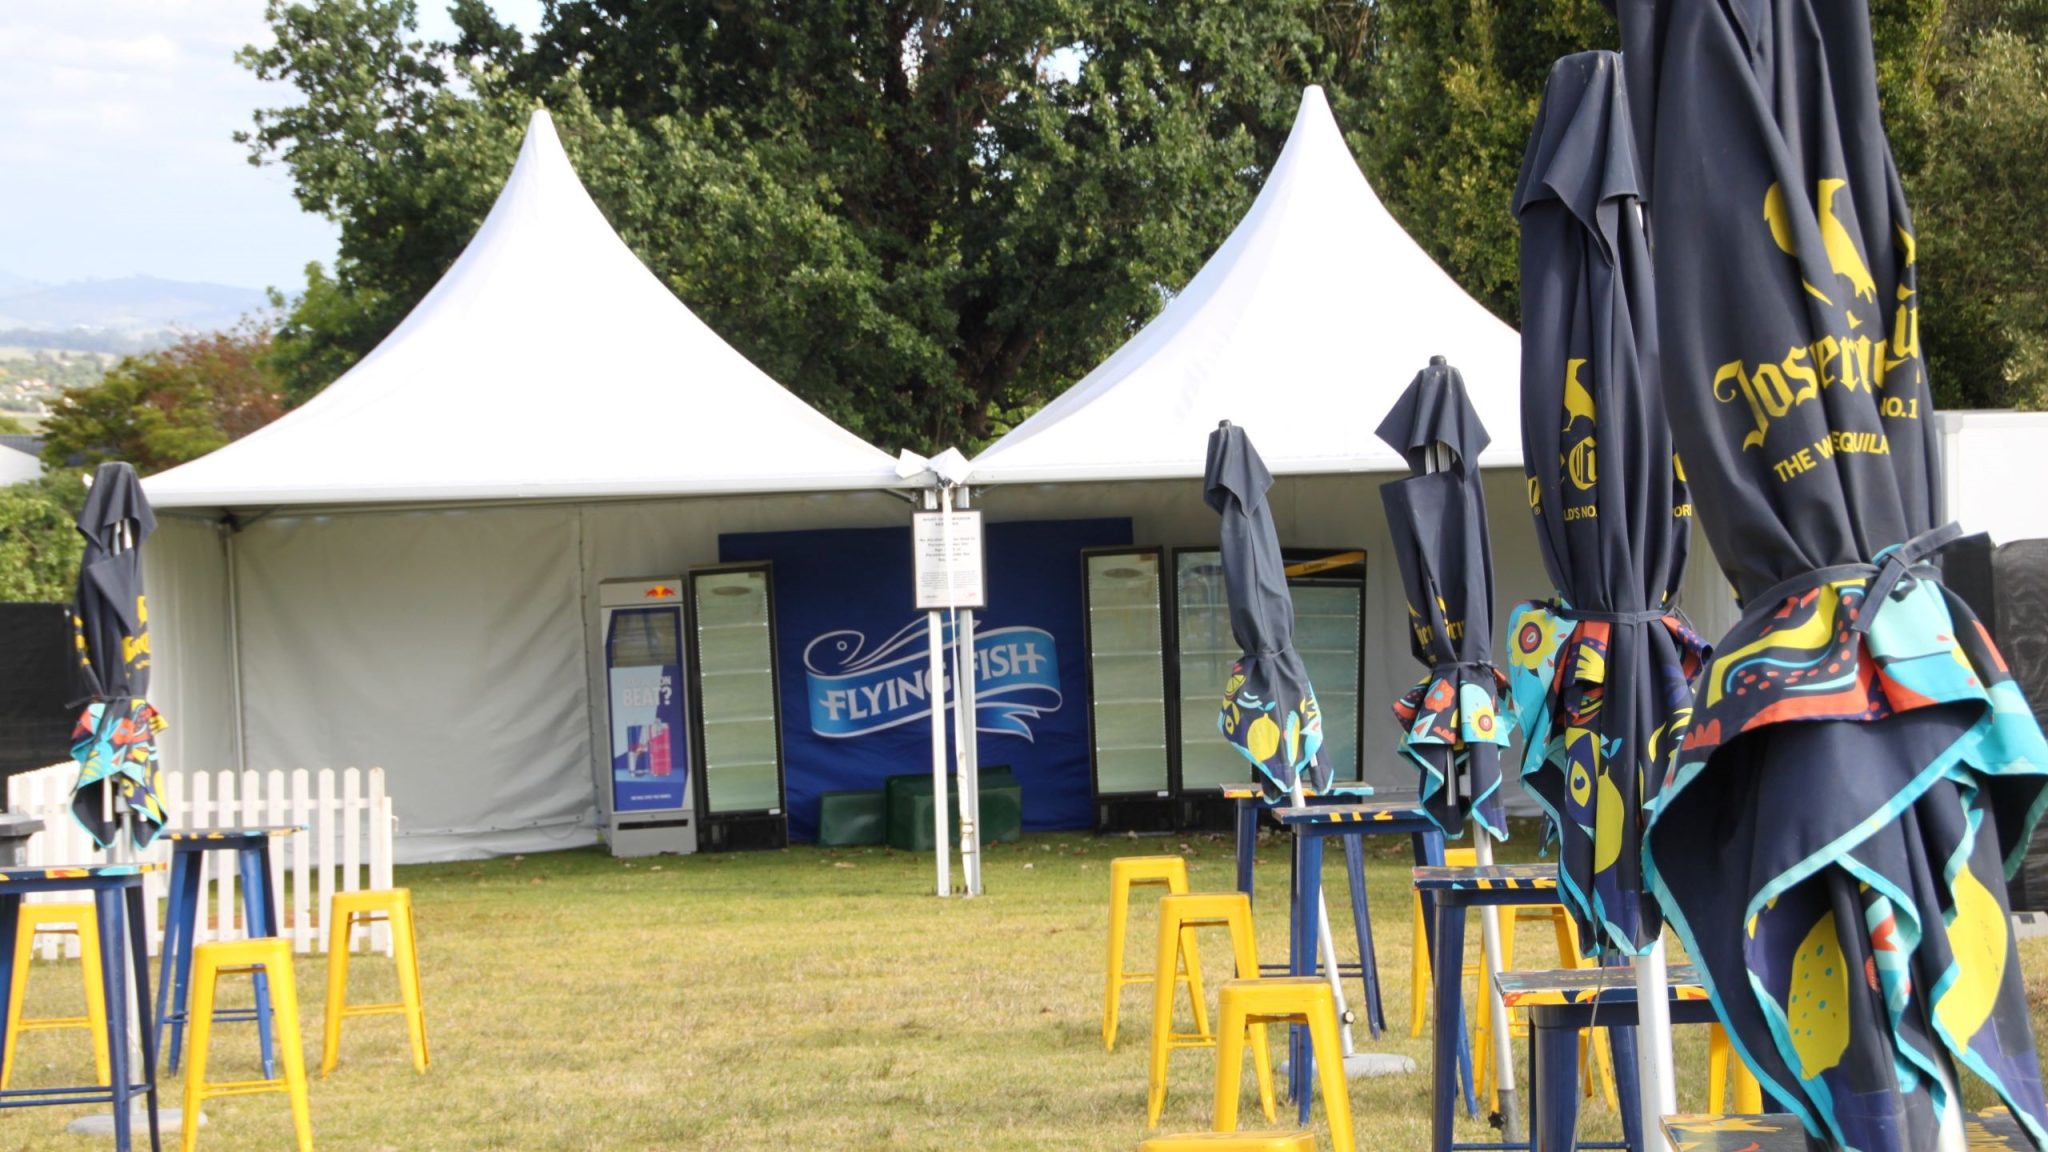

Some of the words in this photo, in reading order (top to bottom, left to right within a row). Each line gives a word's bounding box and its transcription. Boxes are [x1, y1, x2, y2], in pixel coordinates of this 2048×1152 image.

[1832, 431, 1890, 456] EQUILA
[1773, 447, 1818, 483] THE
[623, 686, 673, 706] BEAT?
[819, 661, 951, 722] FLYING
